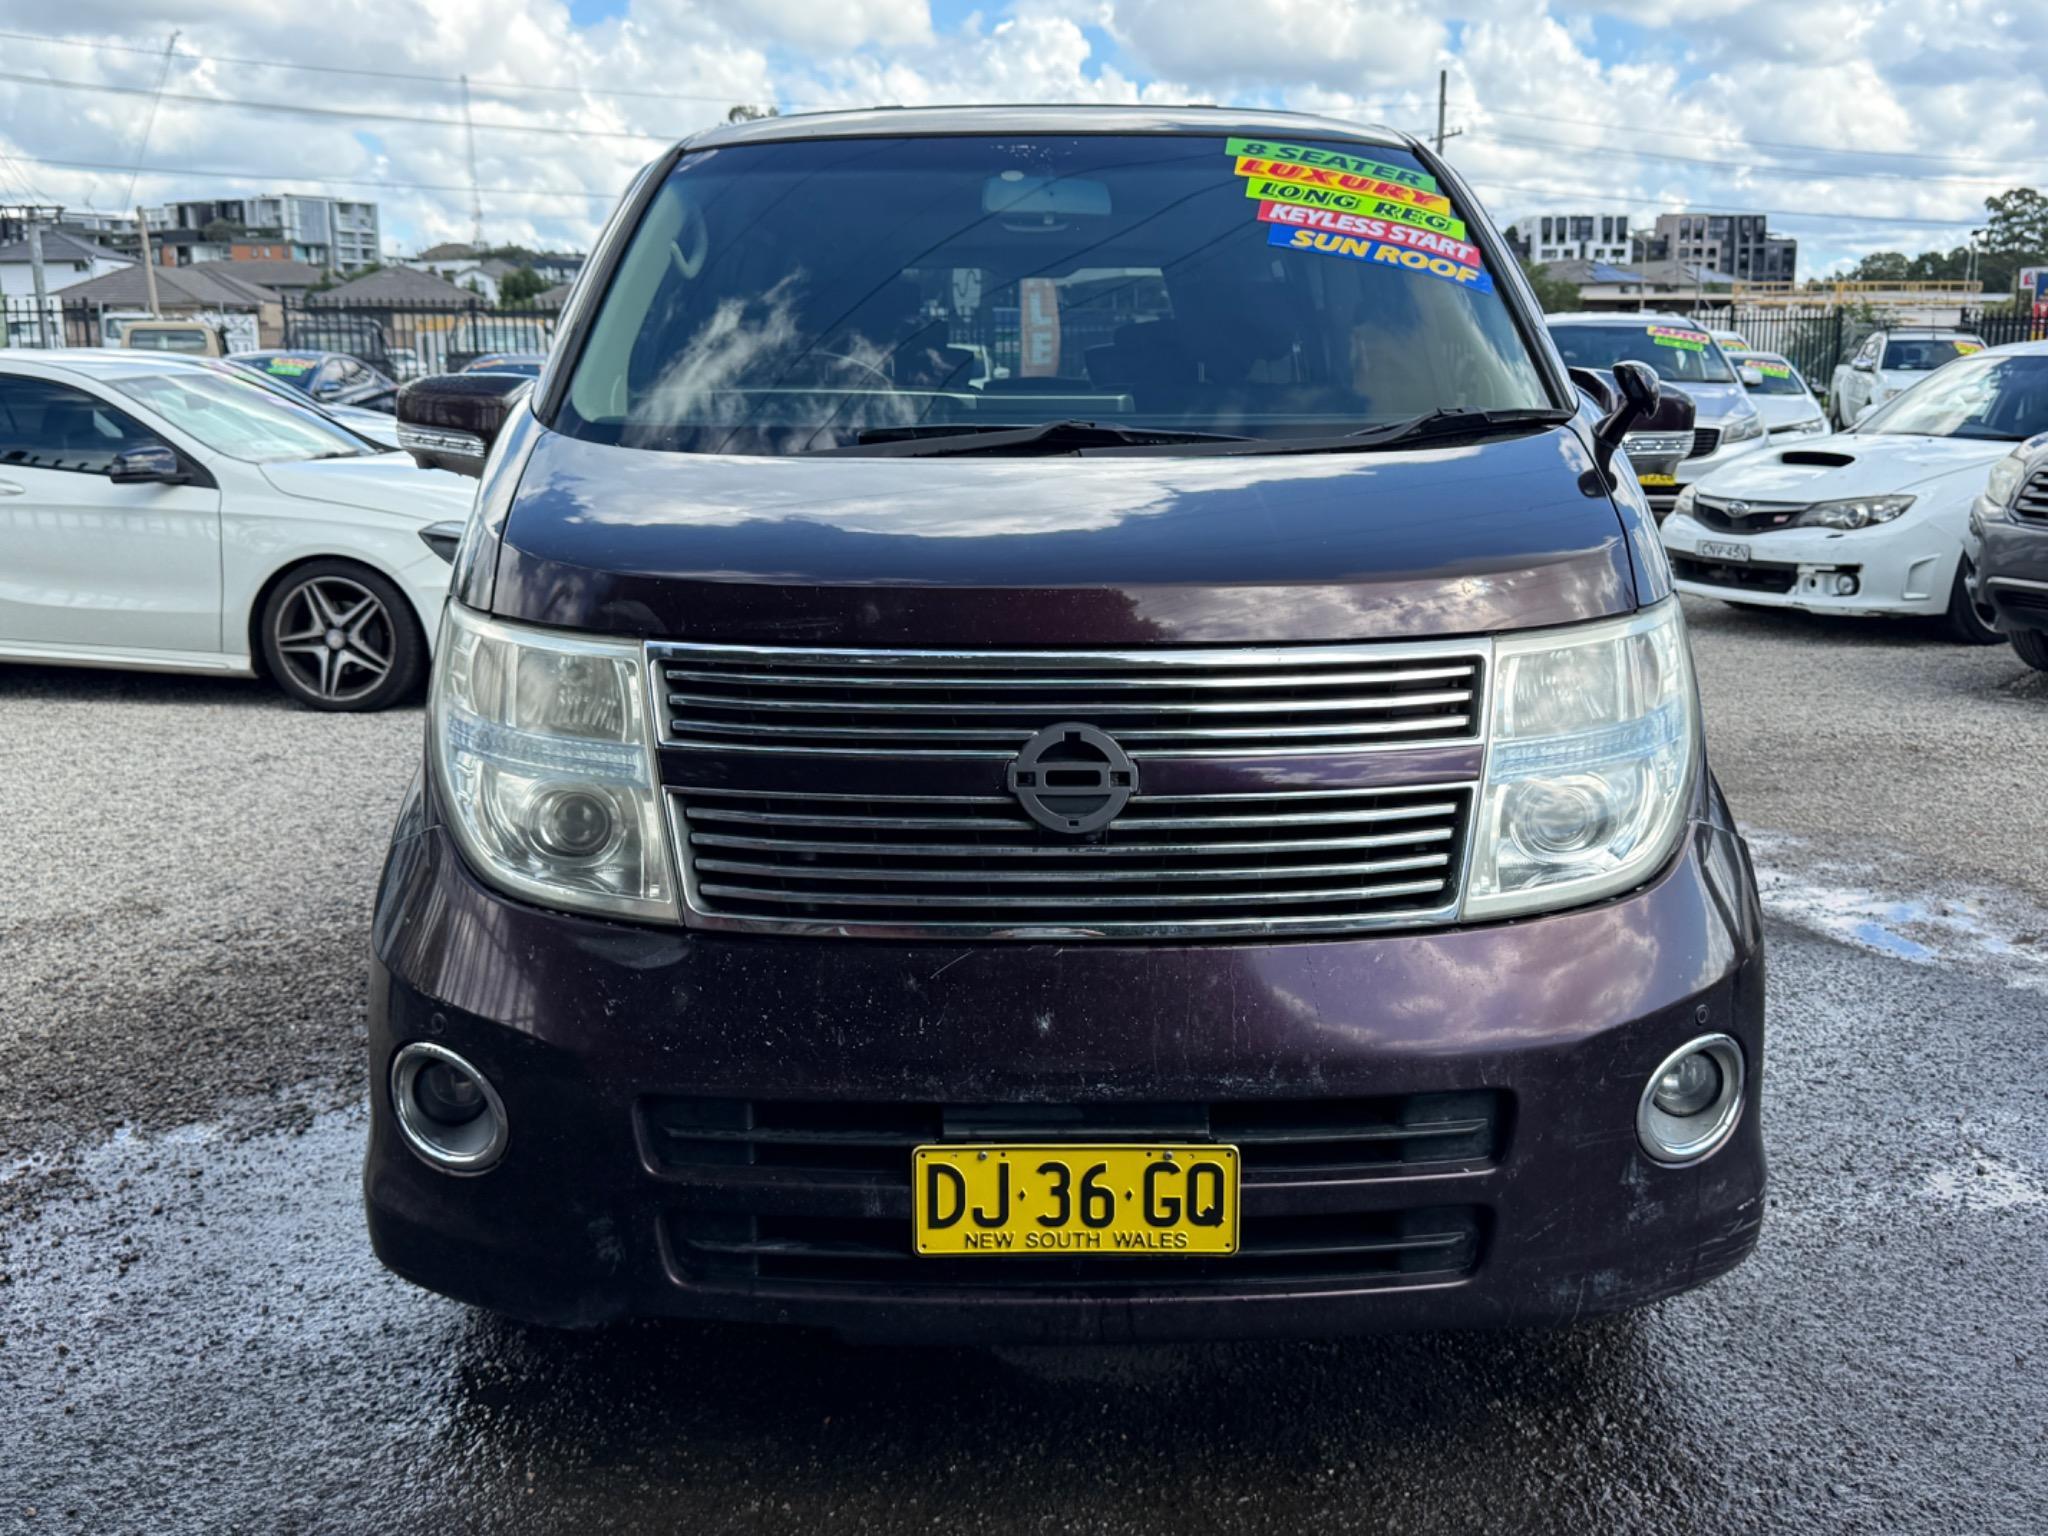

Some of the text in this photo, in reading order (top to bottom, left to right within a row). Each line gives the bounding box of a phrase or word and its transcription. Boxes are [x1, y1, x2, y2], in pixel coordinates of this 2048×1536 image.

[1240, 159, 1440, 205] LUXURY
[1242, 142, 1421, 185] 8 SEATER
[1259, 182, 1451, 231] LONG REG
[1269, 203, 1476, 260] KEYLESS START
[1290, 230, 1480, 283] SUN ROOF
[964, 1232, 1189, 1249] NEW SOUTH WALES
